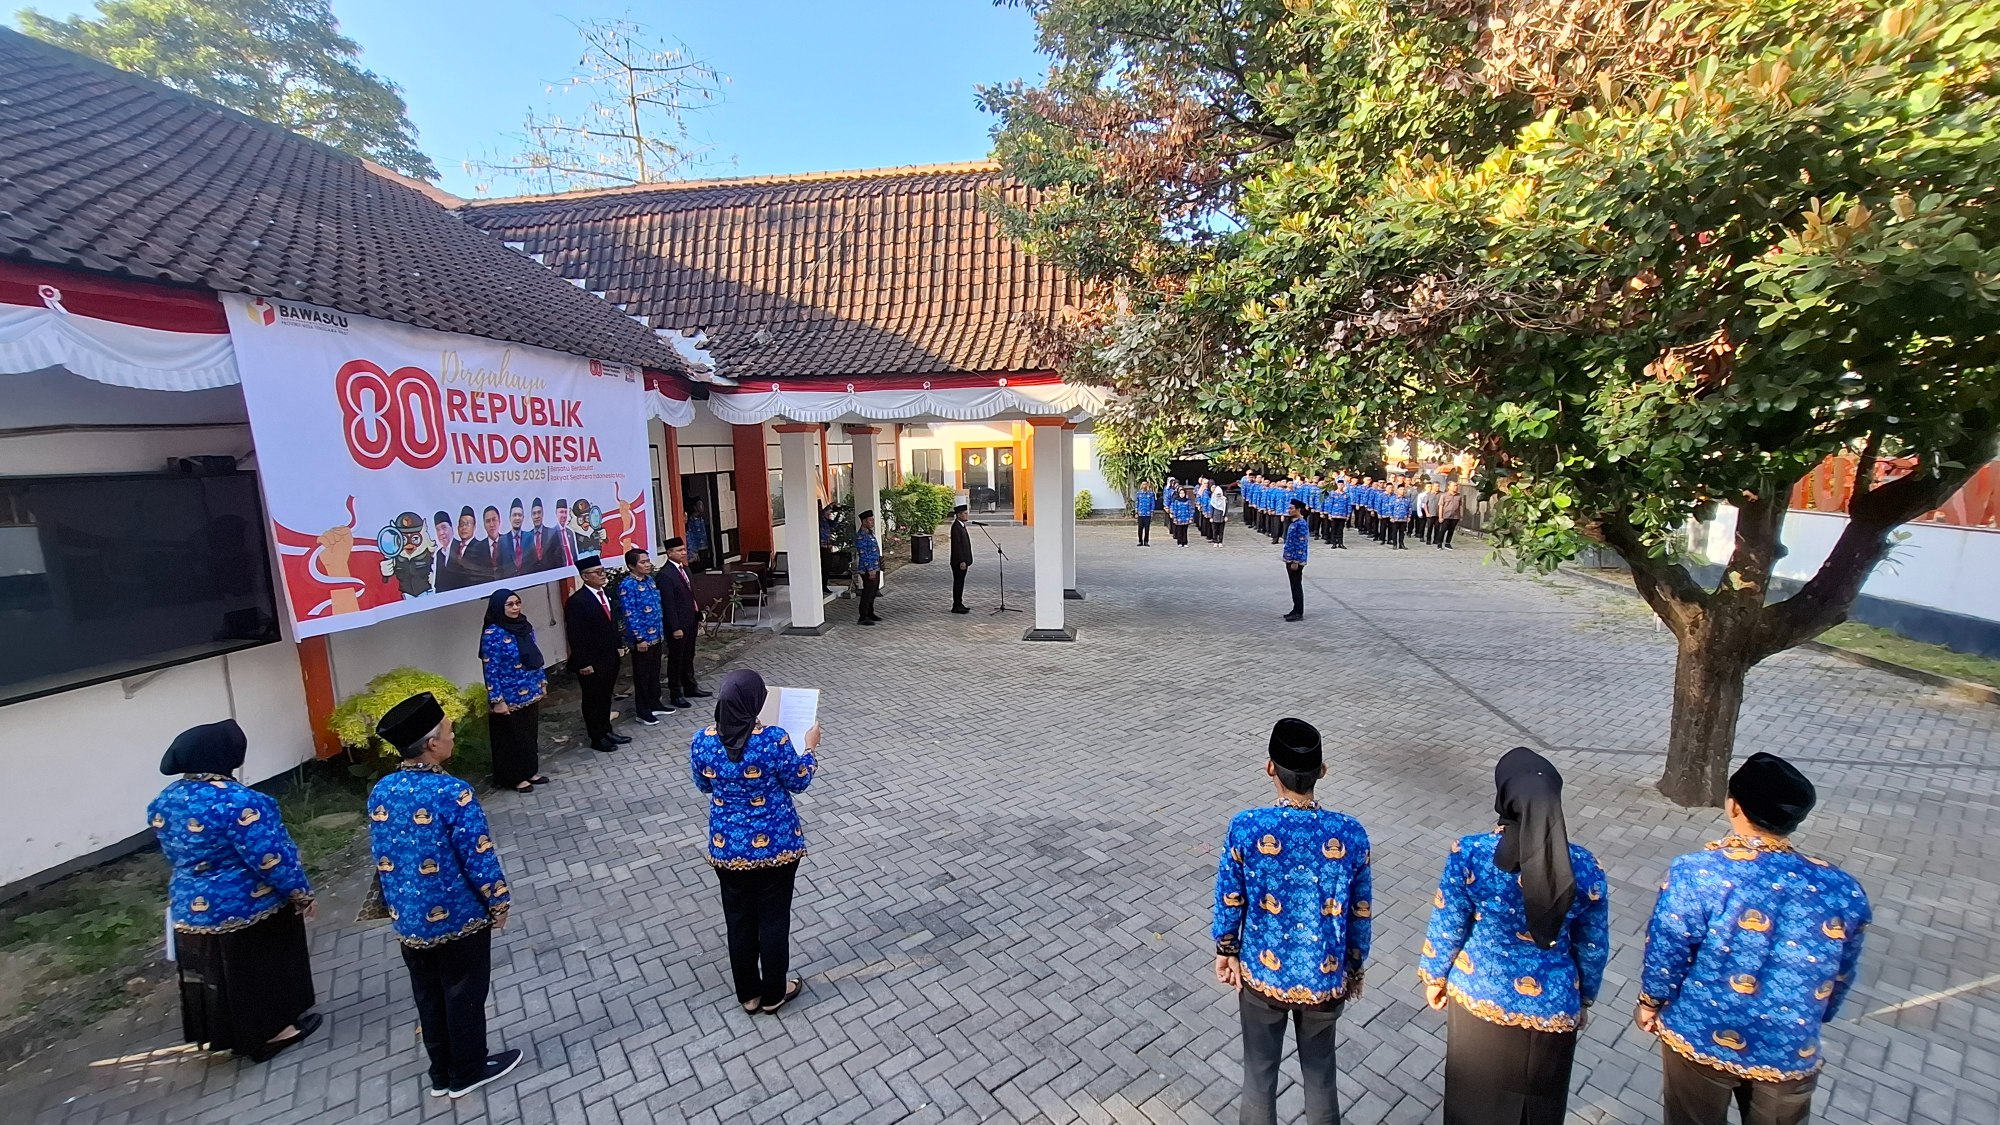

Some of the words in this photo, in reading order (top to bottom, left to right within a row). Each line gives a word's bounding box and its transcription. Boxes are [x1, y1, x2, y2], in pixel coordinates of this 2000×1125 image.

[279, 305, 348, 328] BAWASLU
[440, 349, 548, 405] Dirgahayu
[335, 359, 448, 470] 80
[446, 388, 584, 428] REPUBLIK
[450, 432, 602, 465] INDONESIA
[451, 471, 463, 484] 17
[466, 470, 521, 484] AGUSTUS
[522, 468, 546, 481] 2025
